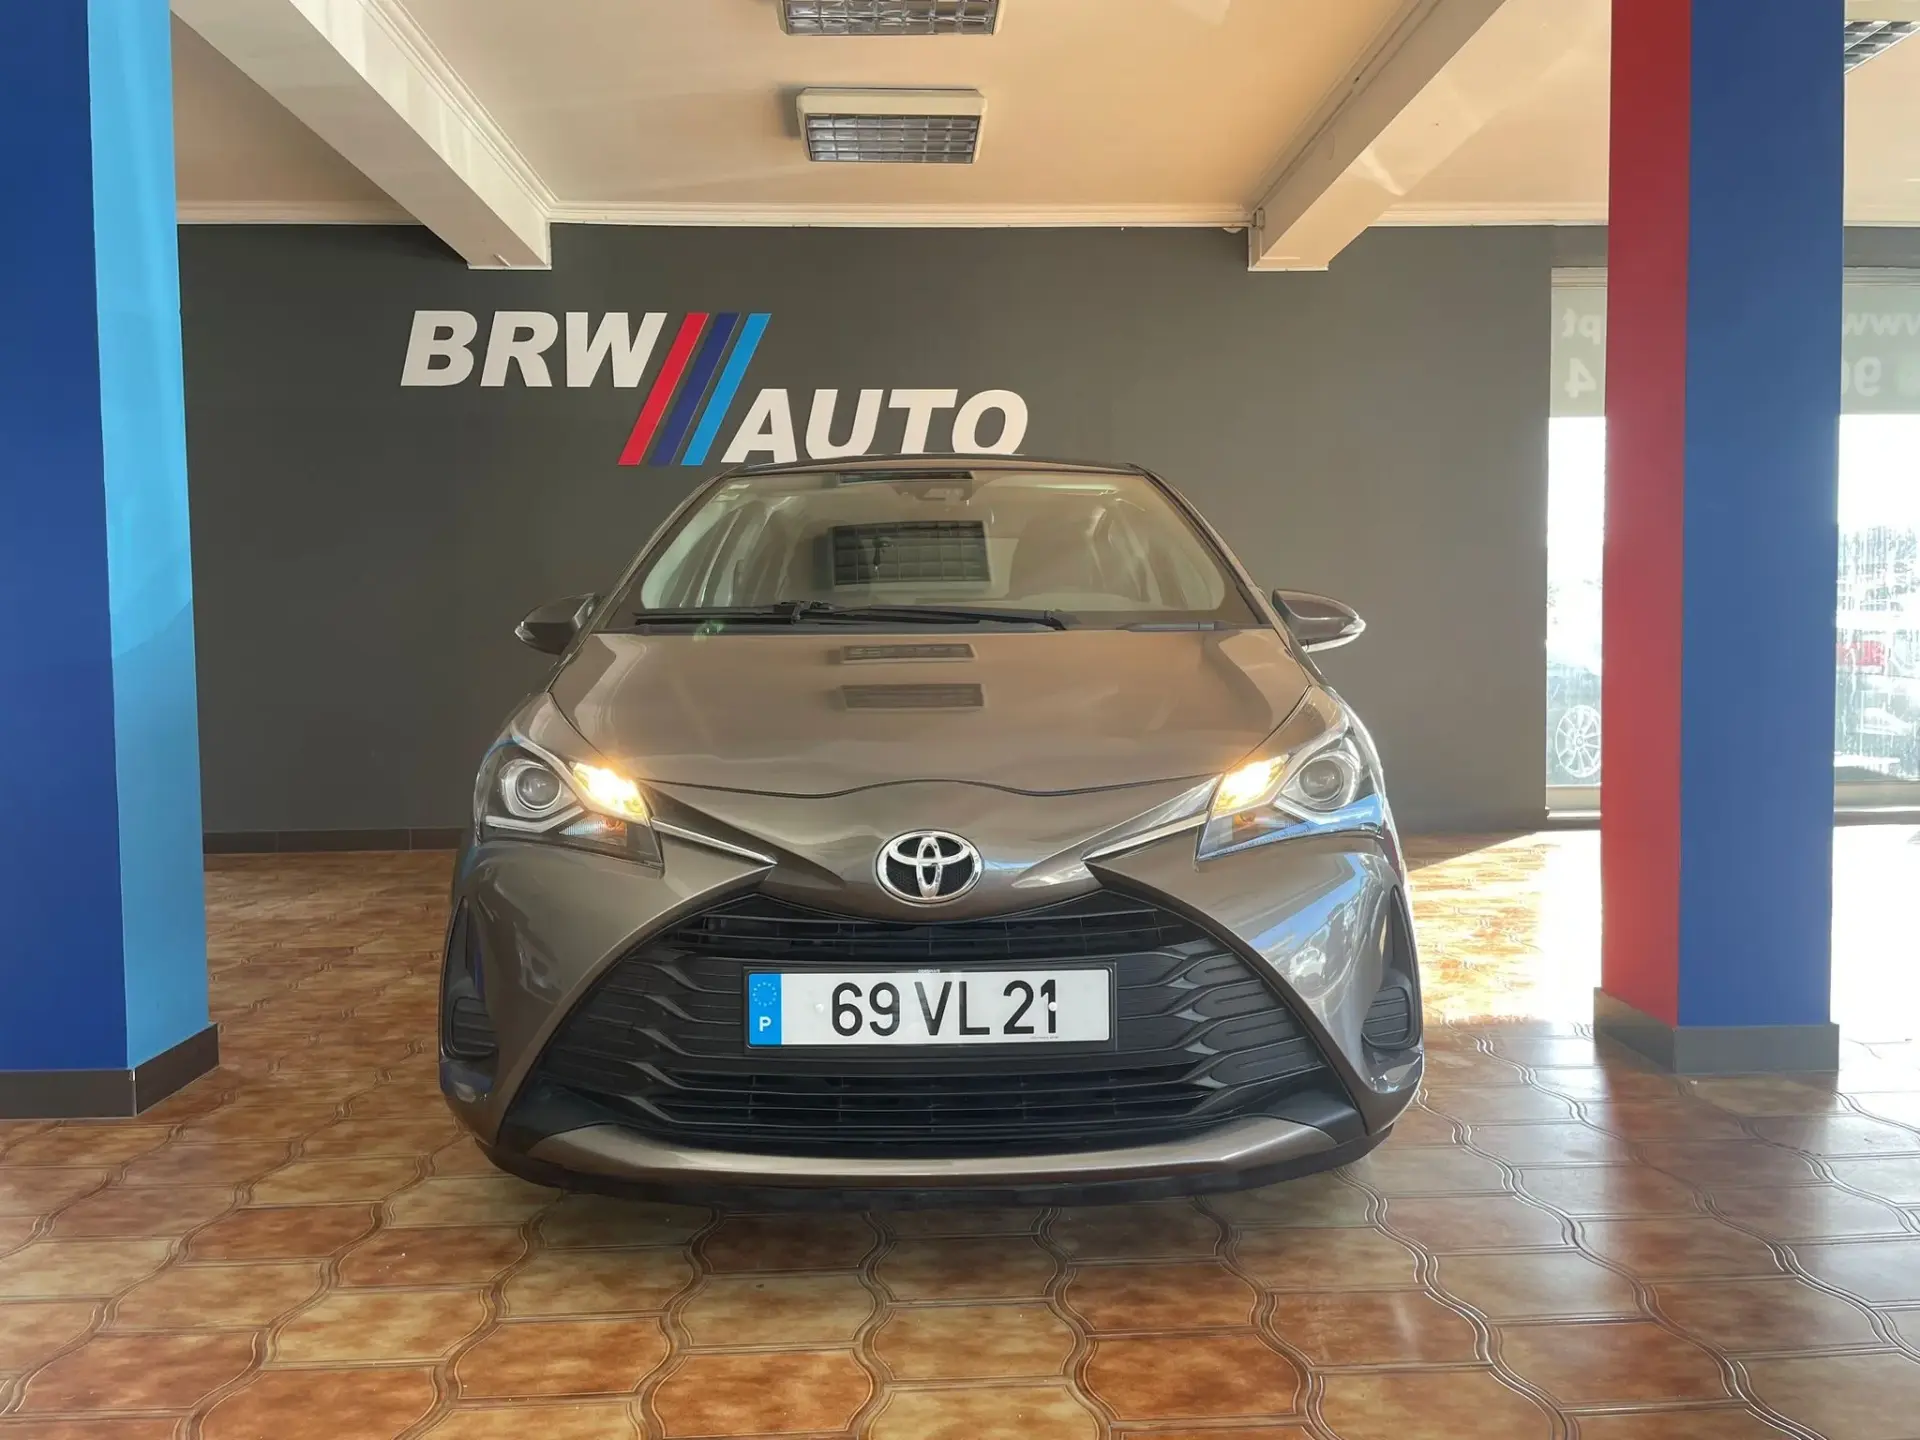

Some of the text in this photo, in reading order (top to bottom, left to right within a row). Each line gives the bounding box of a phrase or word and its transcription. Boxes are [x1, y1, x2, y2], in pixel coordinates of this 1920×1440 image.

[400, 310, 668, 387] BRW
[720, 387, 1029, 463] AUTO
[759, 1016, 772, 1032] P
[831, 979, 1057, 1037] 69 VL 21
